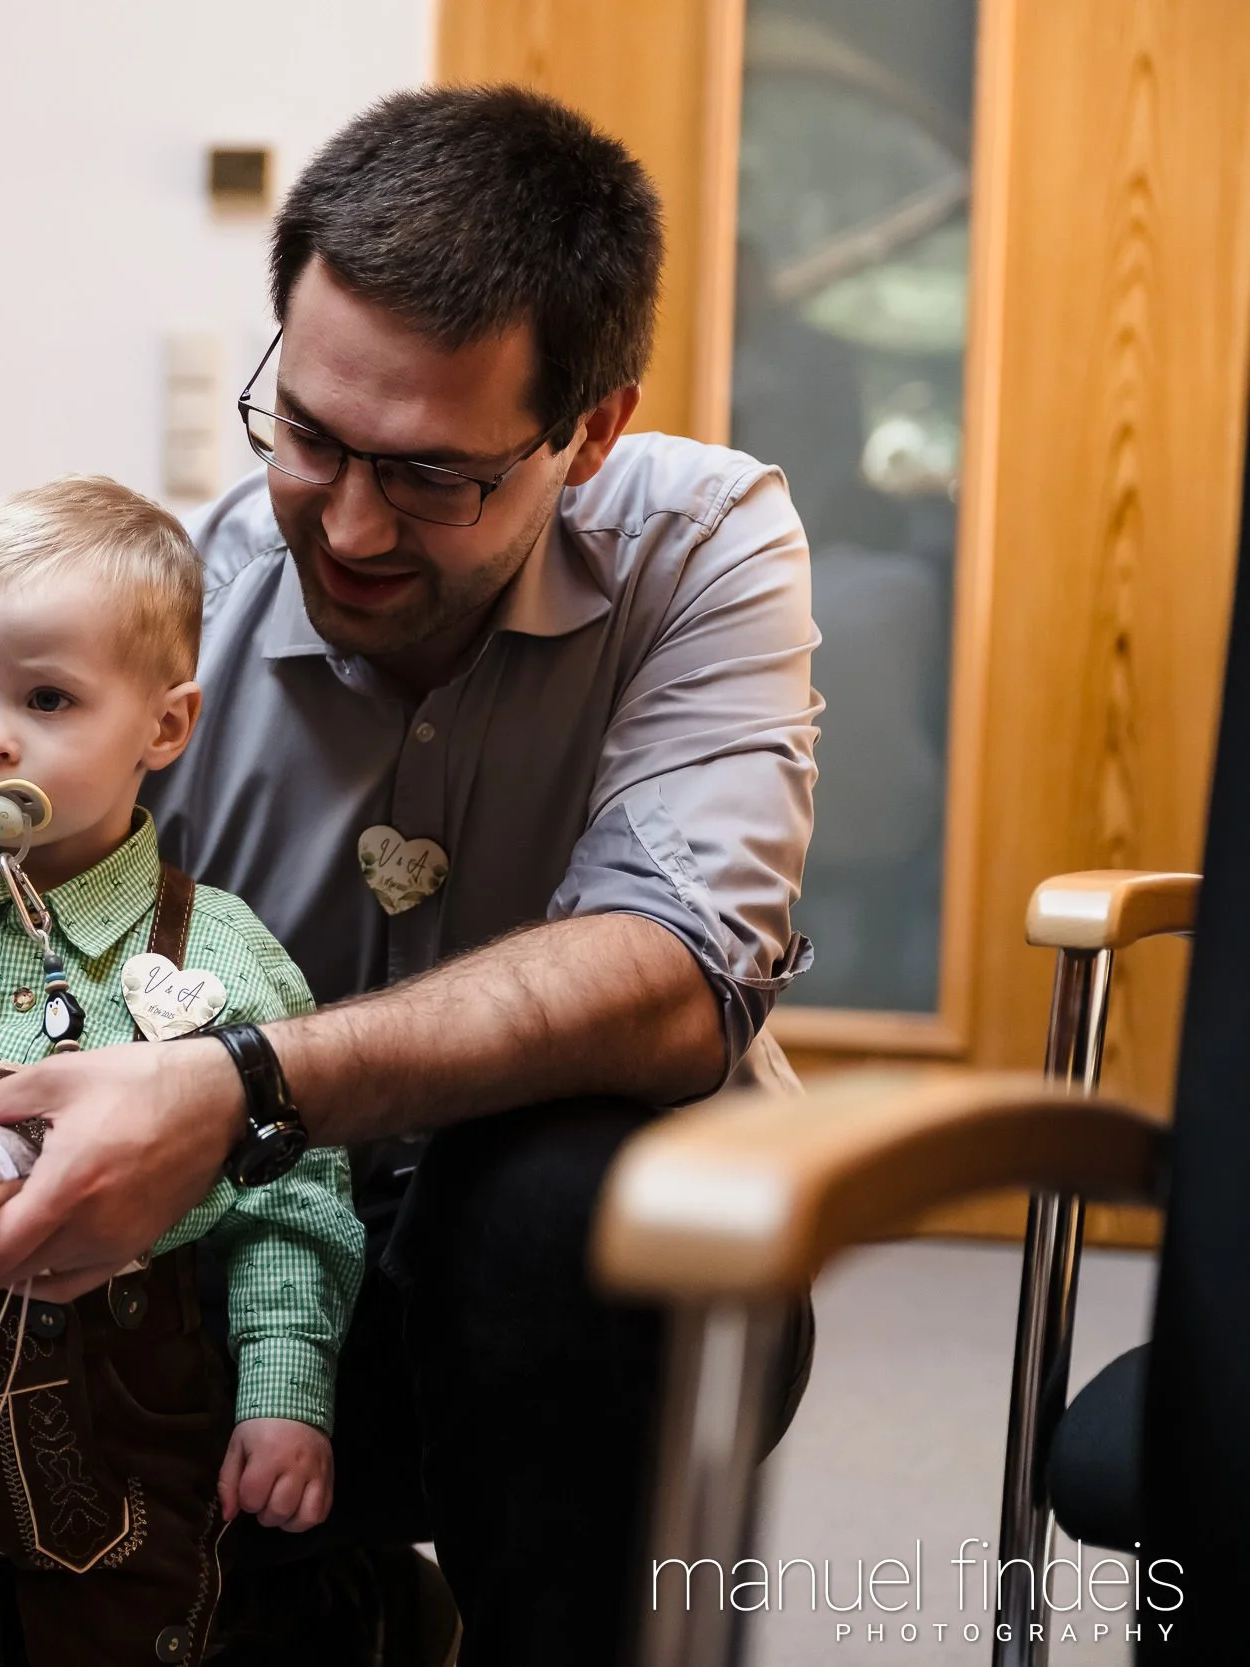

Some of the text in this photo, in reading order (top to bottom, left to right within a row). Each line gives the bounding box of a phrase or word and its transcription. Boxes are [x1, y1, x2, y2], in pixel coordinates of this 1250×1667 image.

[378, 838, 401, 867] V
[407, 850, 429, 884] A
[144, 966, 173, 993] V
[177, 981, 205, 1012] A
